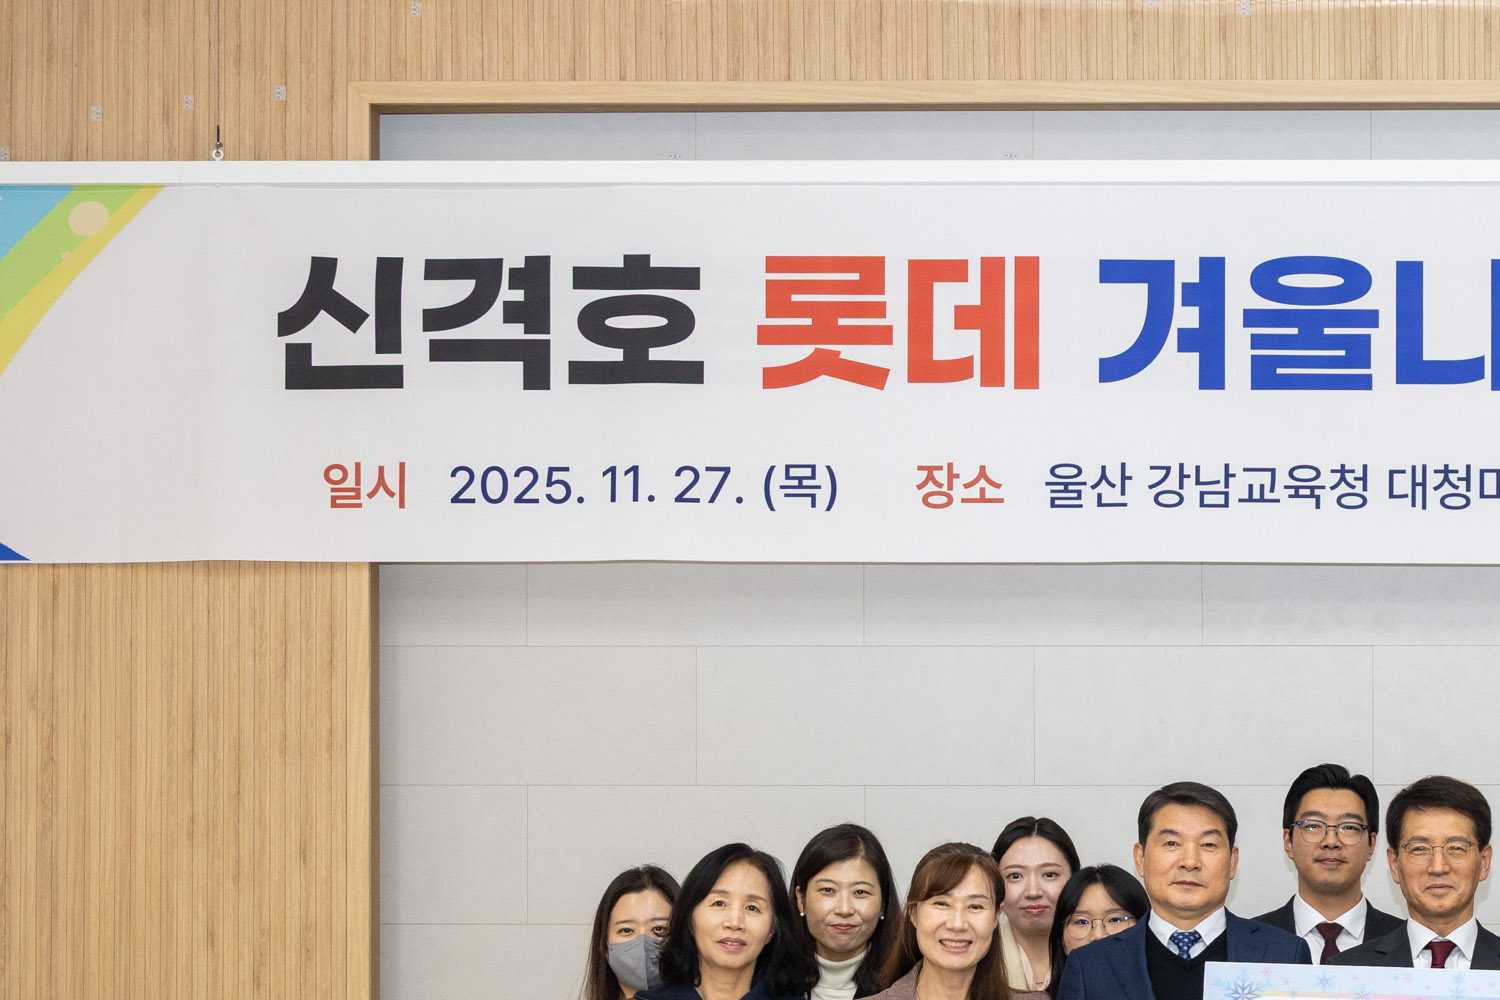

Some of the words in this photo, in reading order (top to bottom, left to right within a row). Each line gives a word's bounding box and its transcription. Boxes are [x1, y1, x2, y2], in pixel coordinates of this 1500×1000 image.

[278, 254, 704, 390] 신격호
[757, 256, 1039, 390] 롯데
[324, 462, 405, 508] 일시
[451, 466, 584, 504] 2025.
[603, 465, 655, 502] 11.
[675, 466, 743, 504] 27.
[764, 464, 837, 511] (목)
[916, 462, 1004, 509] 장소
[1045, 462, 1132, 508] 울산
[1148, 463, 1367, 509] 강남교육청
